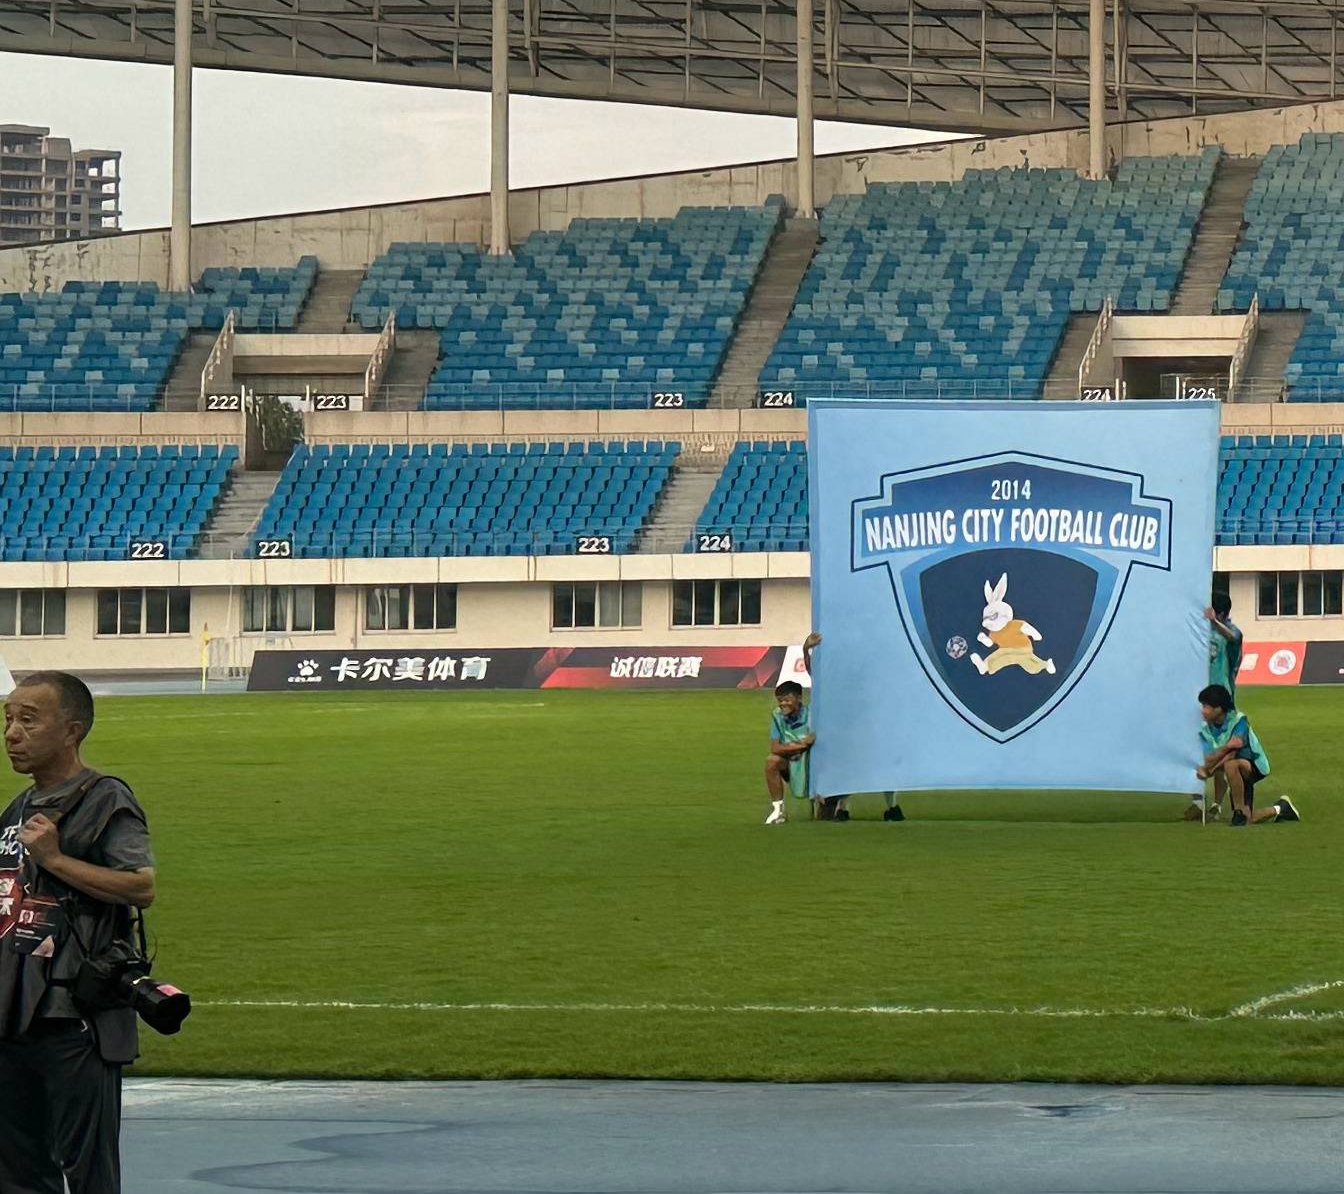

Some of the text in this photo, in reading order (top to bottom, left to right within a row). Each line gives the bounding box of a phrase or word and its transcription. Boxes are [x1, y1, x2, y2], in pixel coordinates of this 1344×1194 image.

[207, 395, 239, 410] 222
[316, 394, 347, 410] 223
[654, 393, 684, 407] 223
[764, 392, 793, 407] 224
[991, 479, 1031, 500] 2014
[864, 507, 1159, 552] NANJING CITY FOOTBALL CLUB
[131, 542, 165, 558] 222
[258, 541, 290, 557] 223
[578, 537, 610, 553] 223
[700, 535, 731, 551] 224
[330, 656, 492, 682] 卡尔美体育
